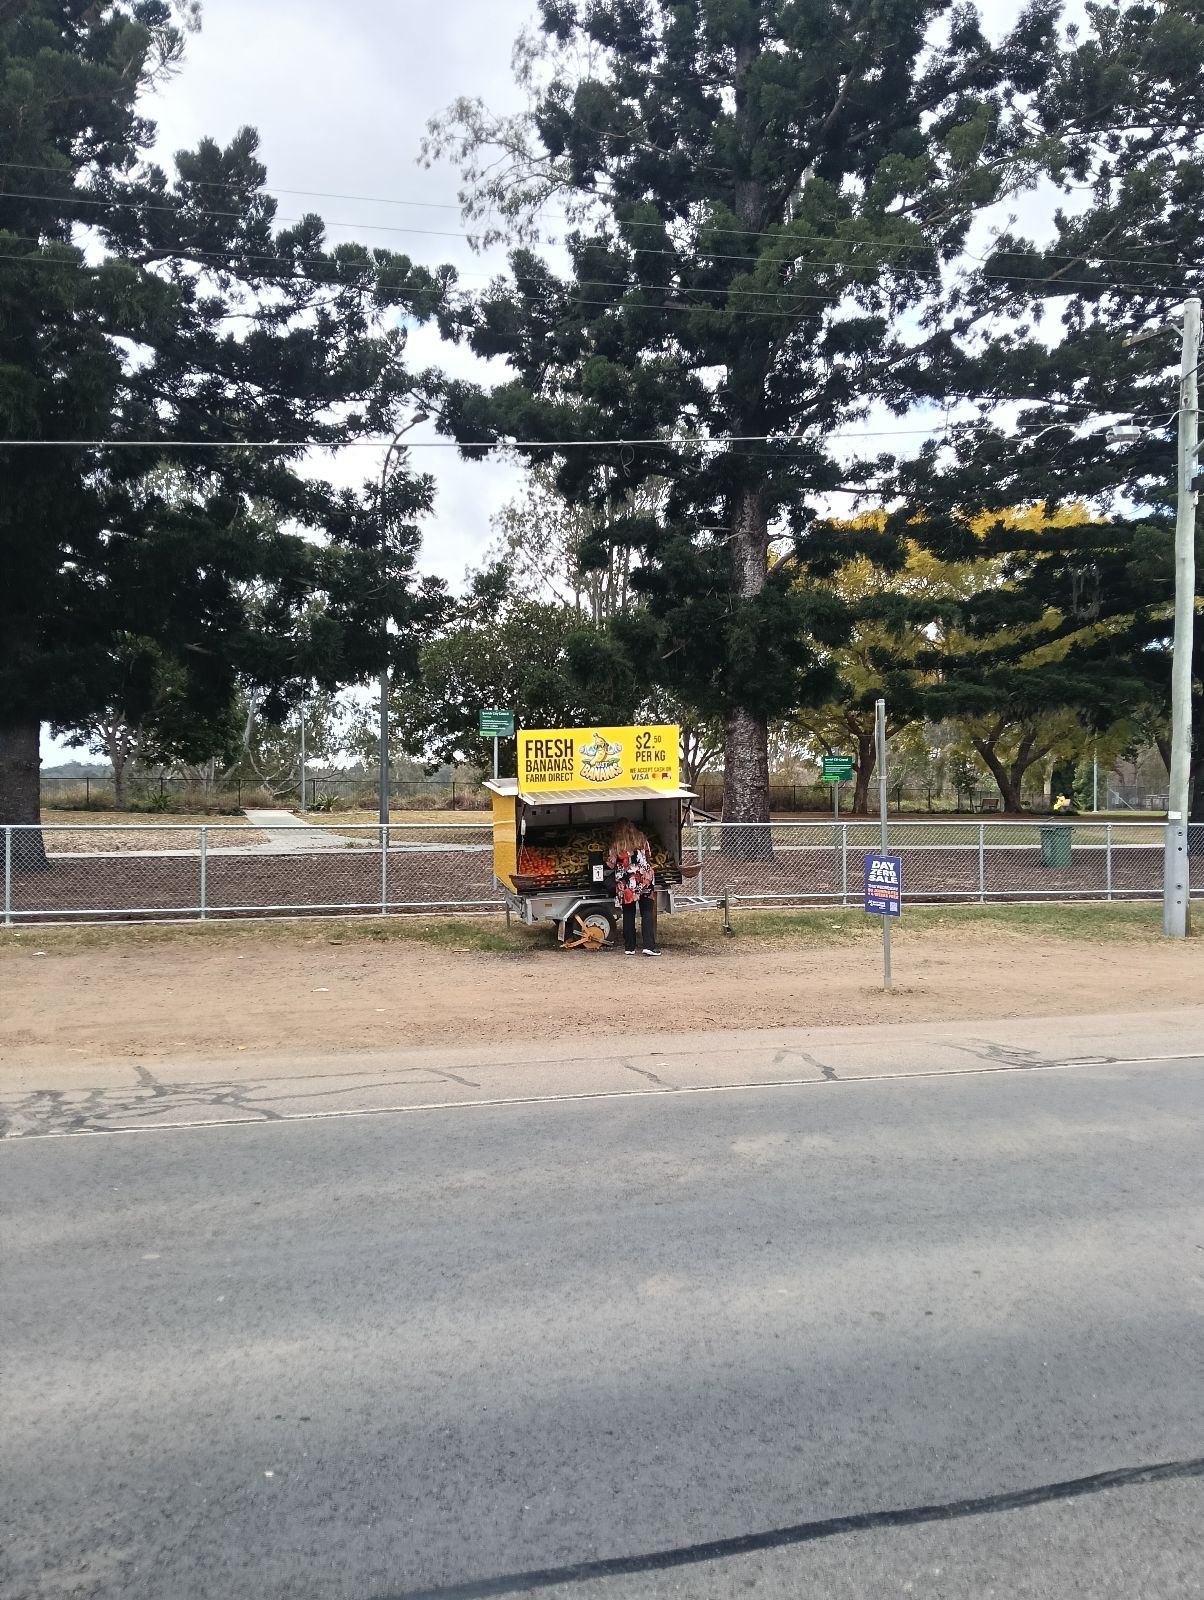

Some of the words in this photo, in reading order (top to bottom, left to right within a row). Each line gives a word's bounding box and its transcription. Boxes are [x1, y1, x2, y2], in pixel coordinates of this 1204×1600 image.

[525, 738, 574, 759] FRESH
[635, 750, 652, 762] PER
[654, 750, 666, 762] KG
[525, 758, 574, 773] BANANAS
[525, 773, 547, 783] FARM
[548, 772, 574, 782] DIRECT
[580, 762, 623, 782] BANANAS
[631, 773, 650, 781] VISA
[872, 861, 895, 870] DAY
[870, 868, 896, 876] ZERO
[868, 875, 898, 884] SALE
